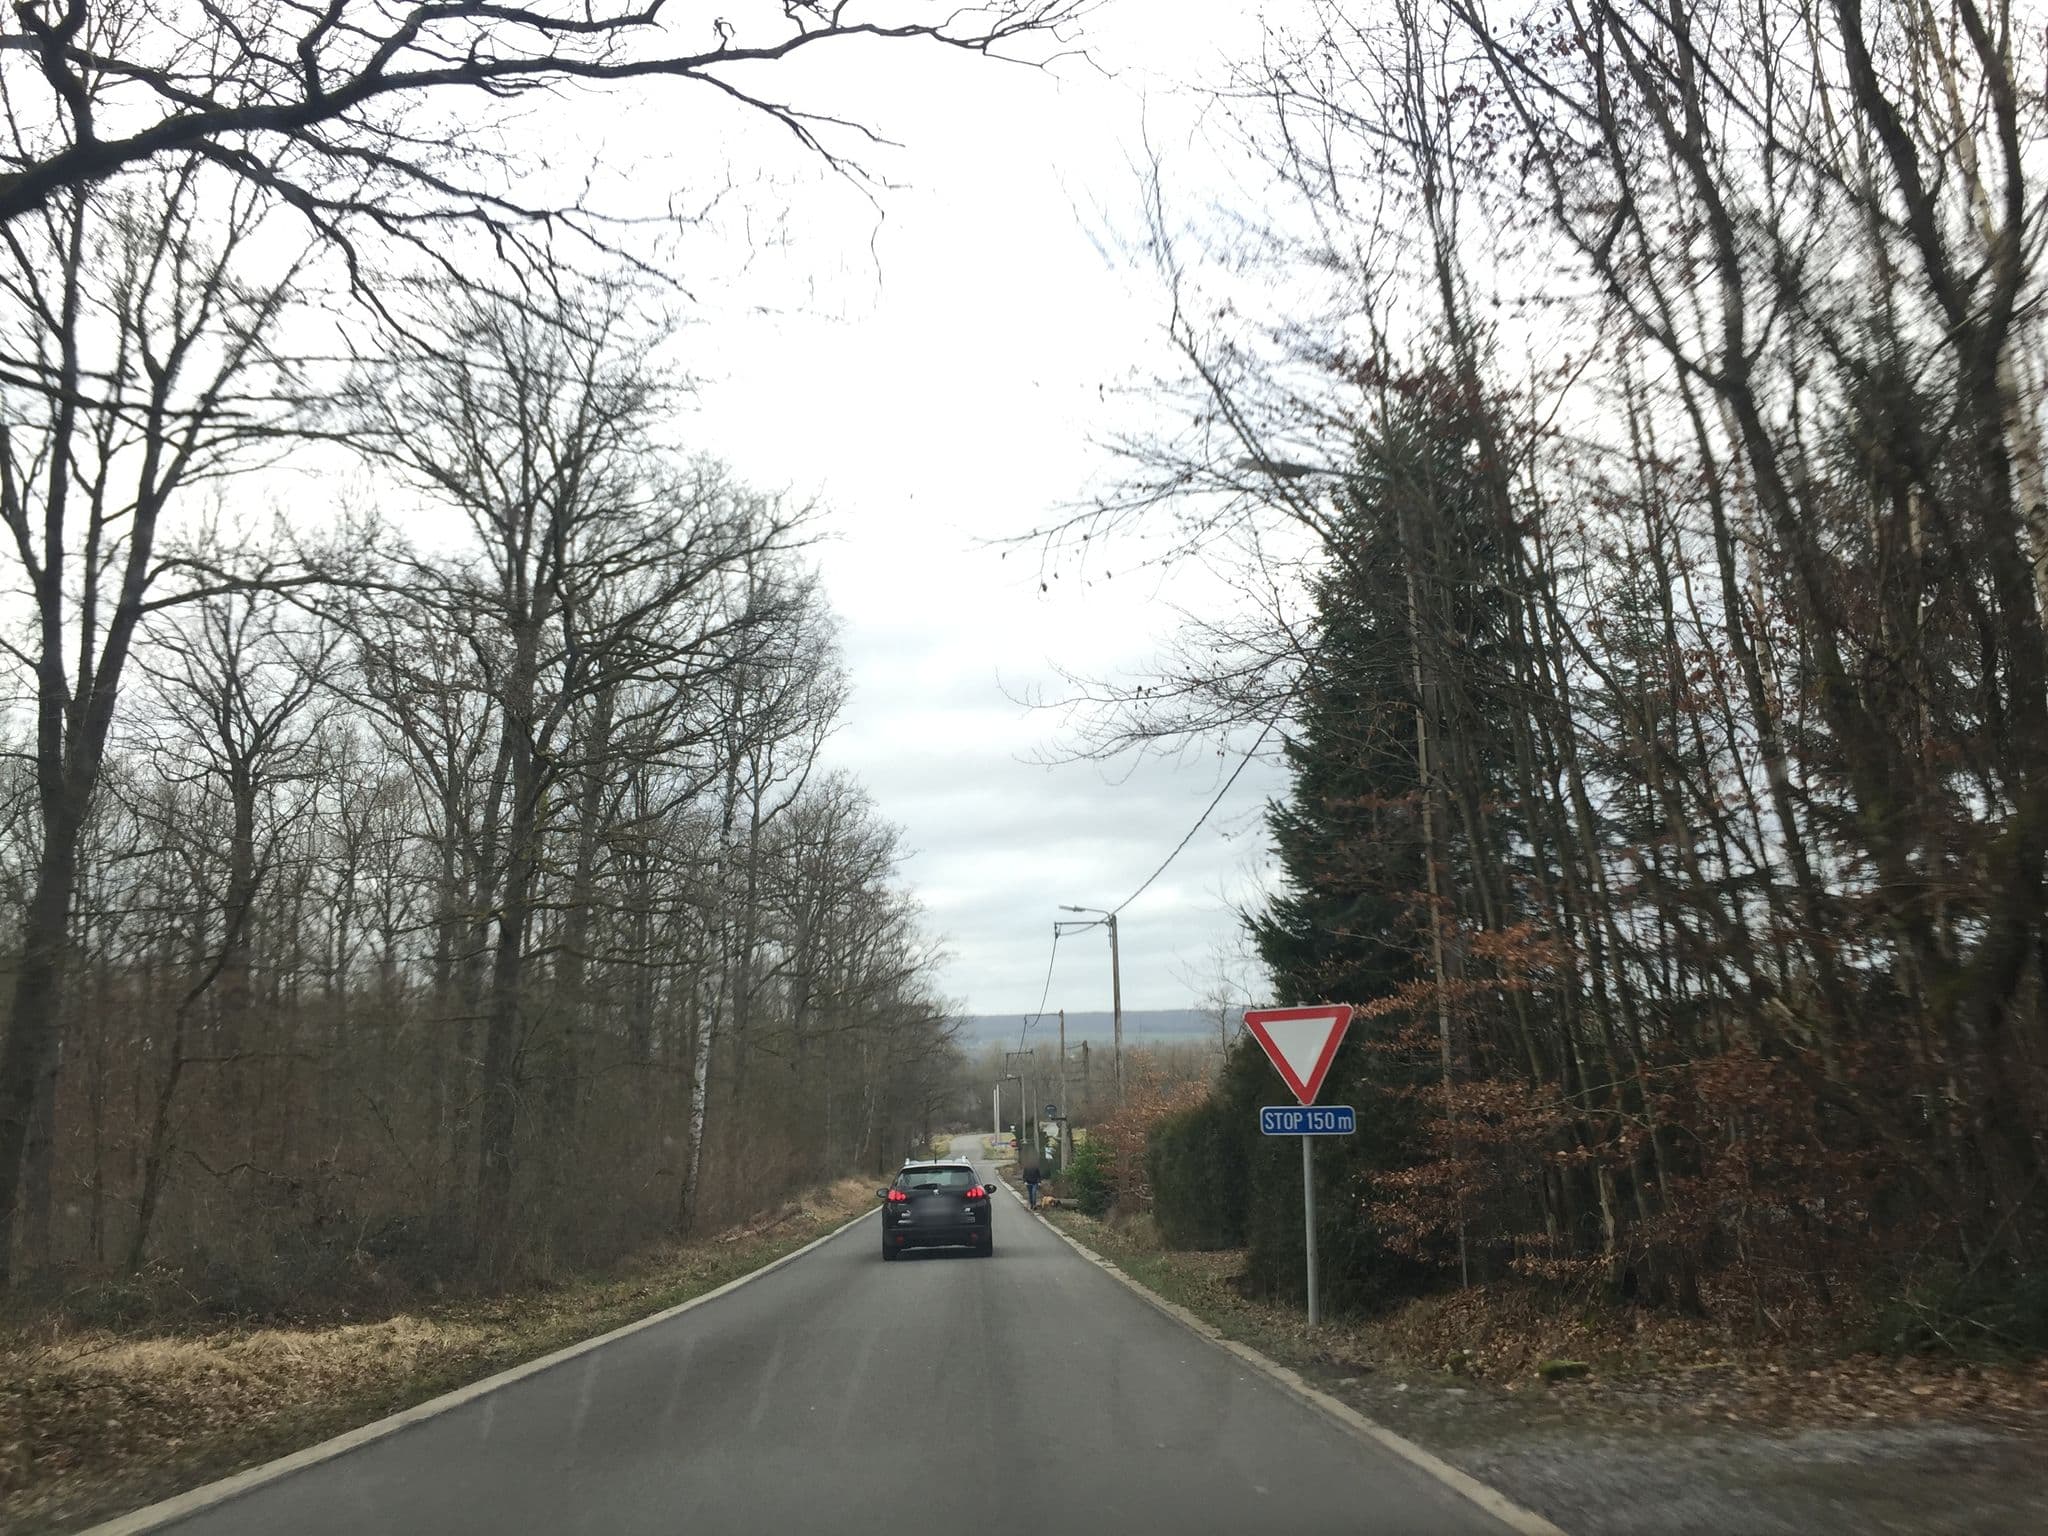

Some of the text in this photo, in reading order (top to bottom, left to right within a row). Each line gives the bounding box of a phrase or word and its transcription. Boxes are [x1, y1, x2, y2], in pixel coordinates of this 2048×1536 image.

[1264, 1112, 1352, 1130] STOP 150 m
